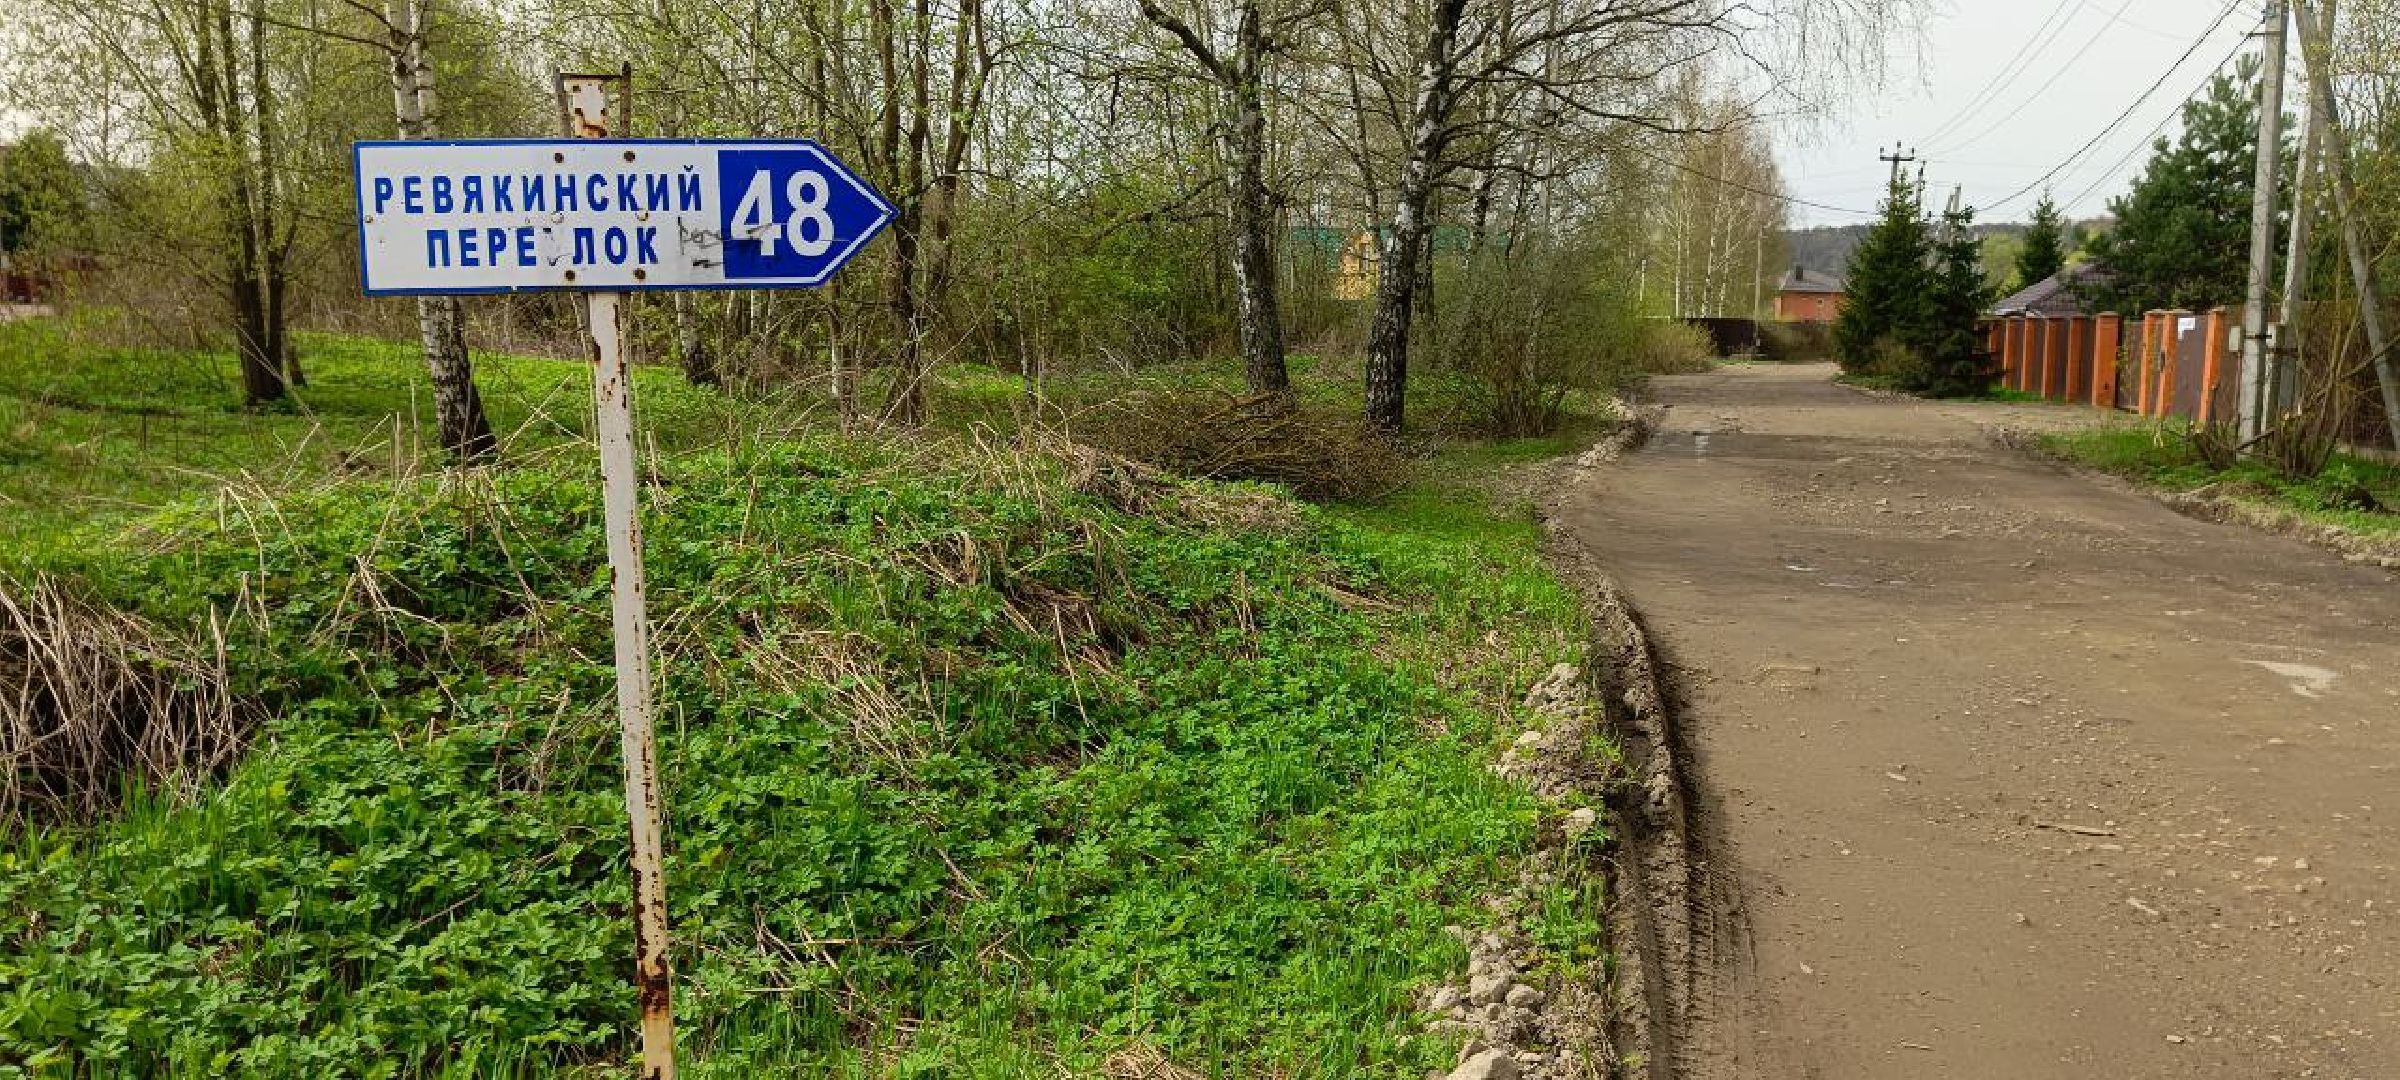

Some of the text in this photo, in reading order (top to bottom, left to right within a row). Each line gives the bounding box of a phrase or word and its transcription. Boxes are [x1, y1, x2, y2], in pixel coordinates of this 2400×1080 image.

[374, 165, 702, 214] РЕВЯКИНСКИЙ
[730, 169, 835, 257] 48
[426, 226, 659, 268] ПЕРЕЛОК
